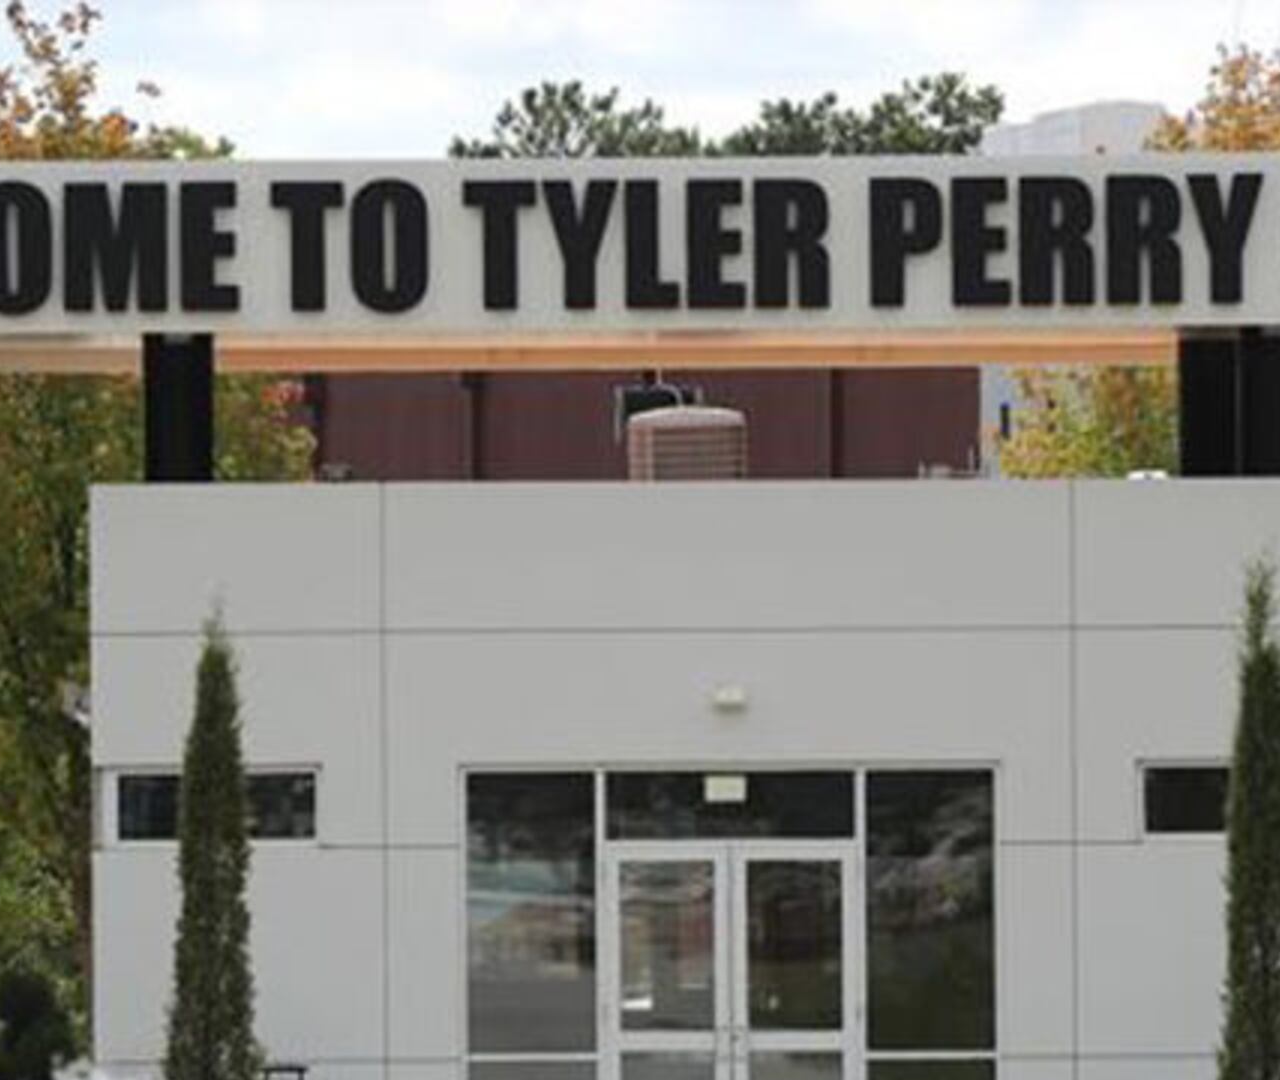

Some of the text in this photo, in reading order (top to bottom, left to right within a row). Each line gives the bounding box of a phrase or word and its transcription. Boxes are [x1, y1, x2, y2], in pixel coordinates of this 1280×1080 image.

[270, 178, 430, 314] TO
[462, 177, 831, 312] TYLER
[869, 172, 1263, 308] PERRY
